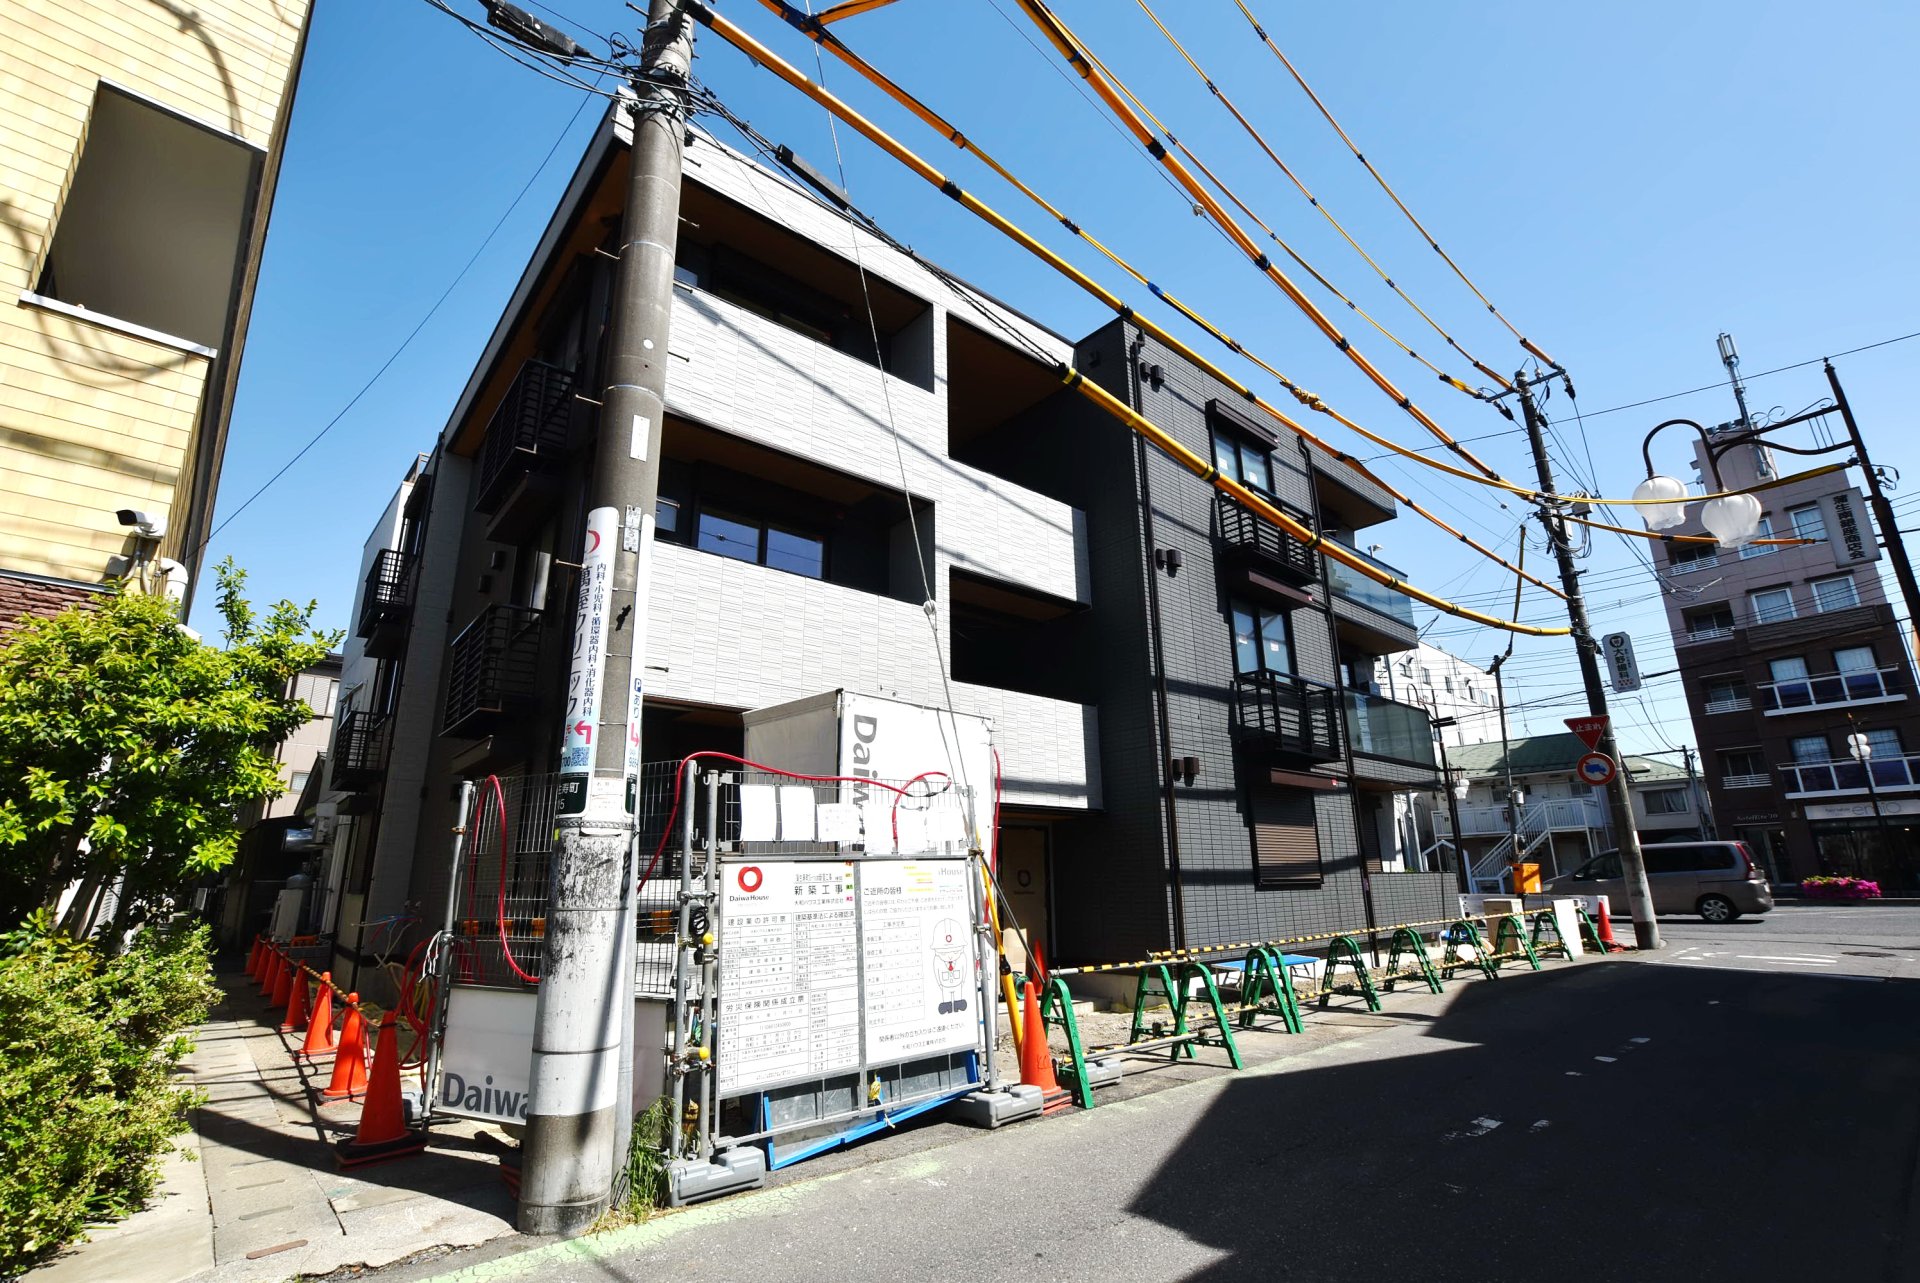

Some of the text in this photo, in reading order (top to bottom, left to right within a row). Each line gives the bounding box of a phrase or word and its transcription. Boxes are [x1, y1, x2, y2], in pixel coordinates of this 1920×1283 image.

[582, 562, 606, 717] 内科・小児科・循環器内科・消化器内科
[1575, 722, 1601, 733] 止まれ
[794, 884, 843, 896] 新築工事
[863, 886, 902, 896] ご近所の皆様
[728, 916, 786, 926] 建設業の許可票
[726, 995, 805, 1012] 労災保険関係成立票
